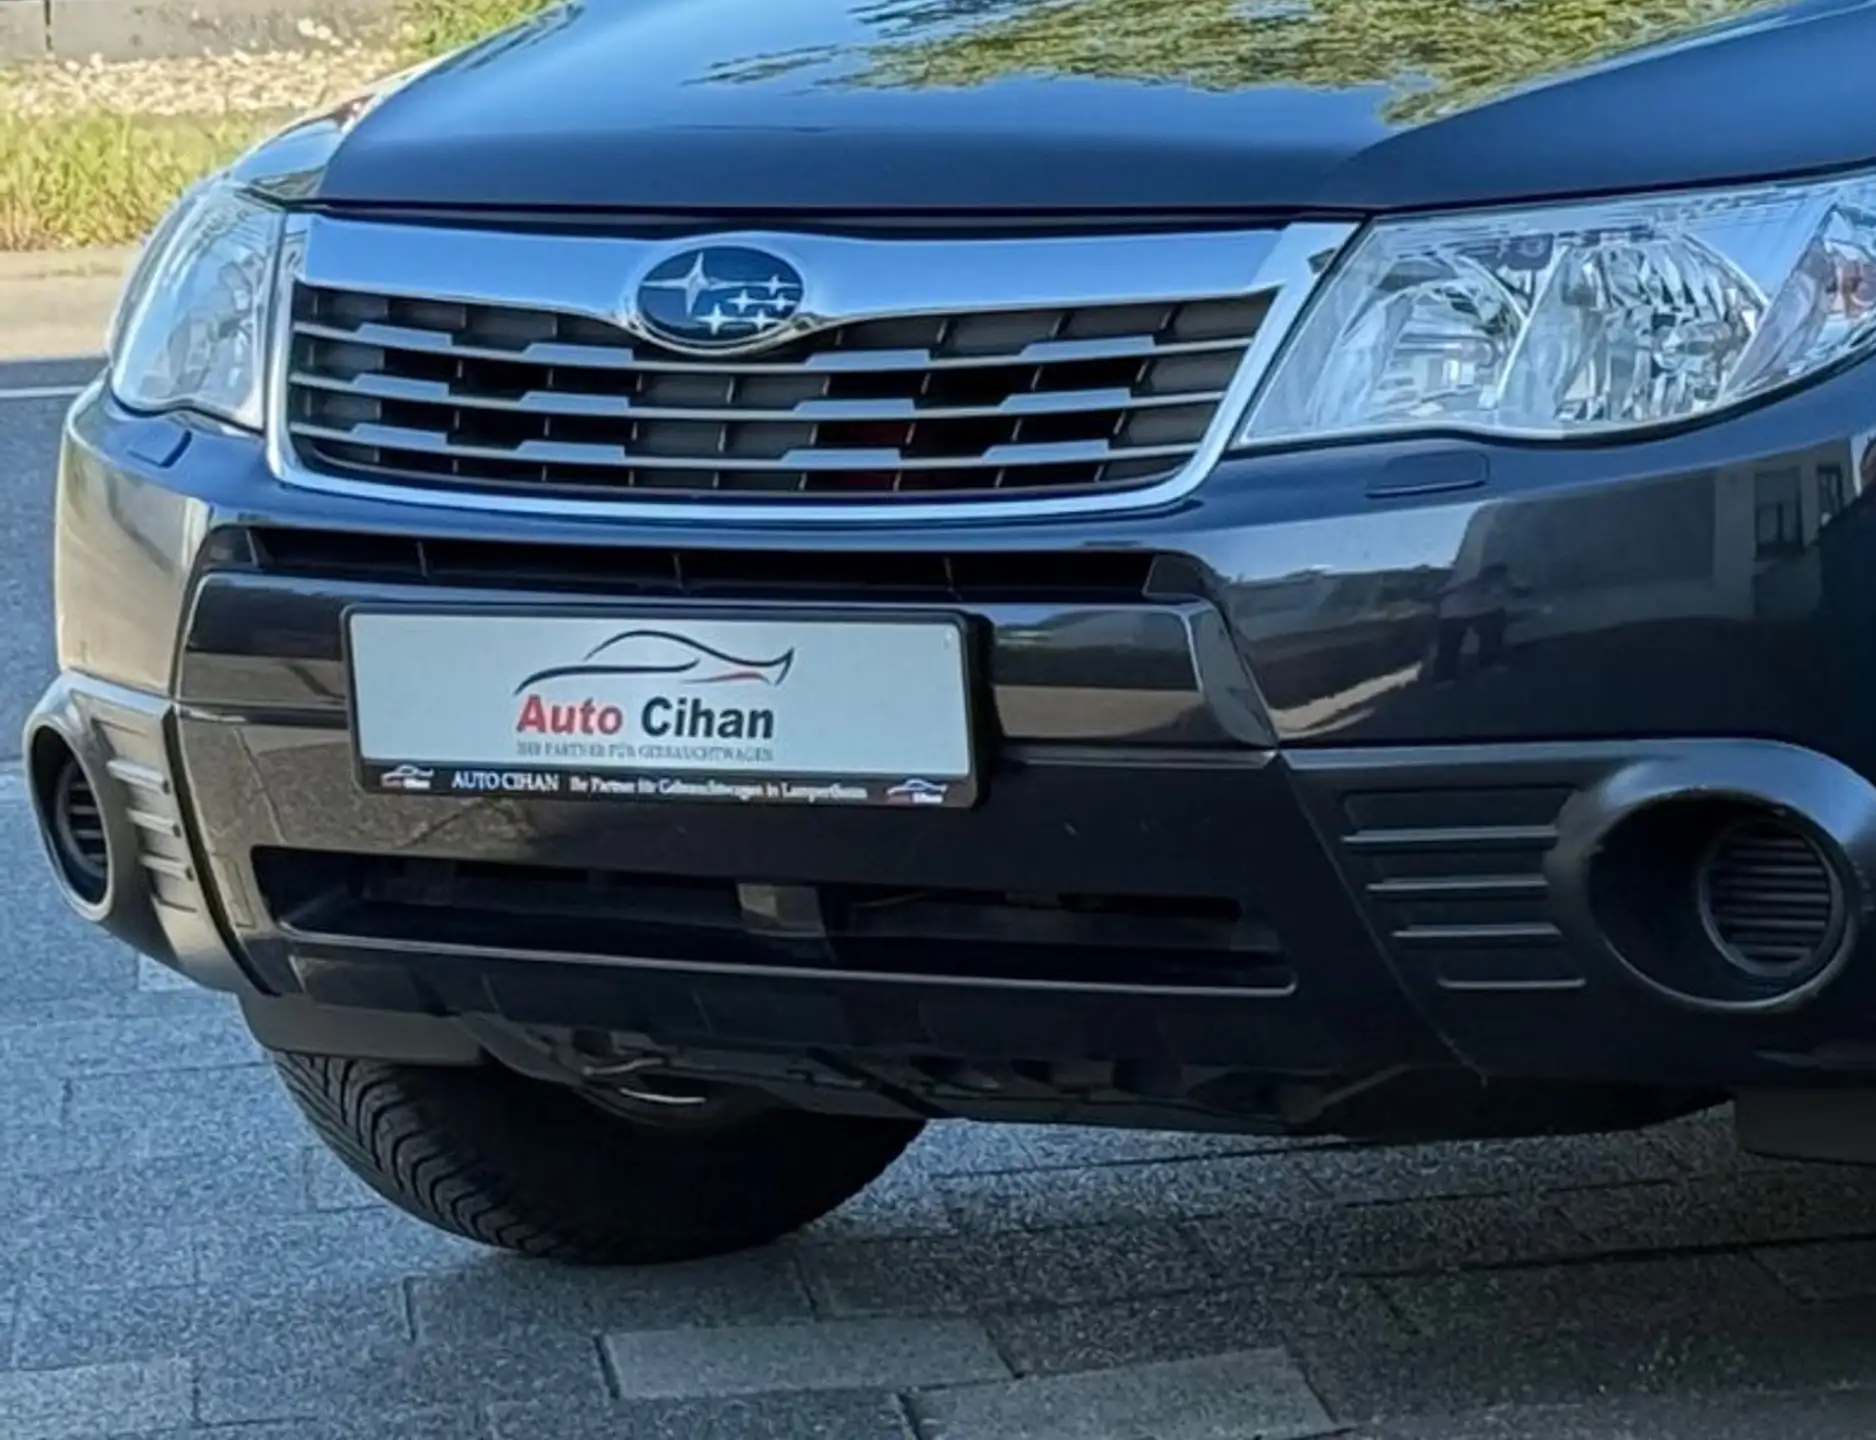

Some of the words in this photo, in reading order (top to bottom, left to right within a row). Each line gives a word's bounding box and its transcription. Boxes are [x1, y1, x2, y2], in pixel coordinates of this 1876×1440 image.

[516, 694, 623, 736] Auto
[641, 696, 775, 740] Cihan
[452, 771, 499, 791] AUTO
[502, 772, 559, 792] CIHAN
